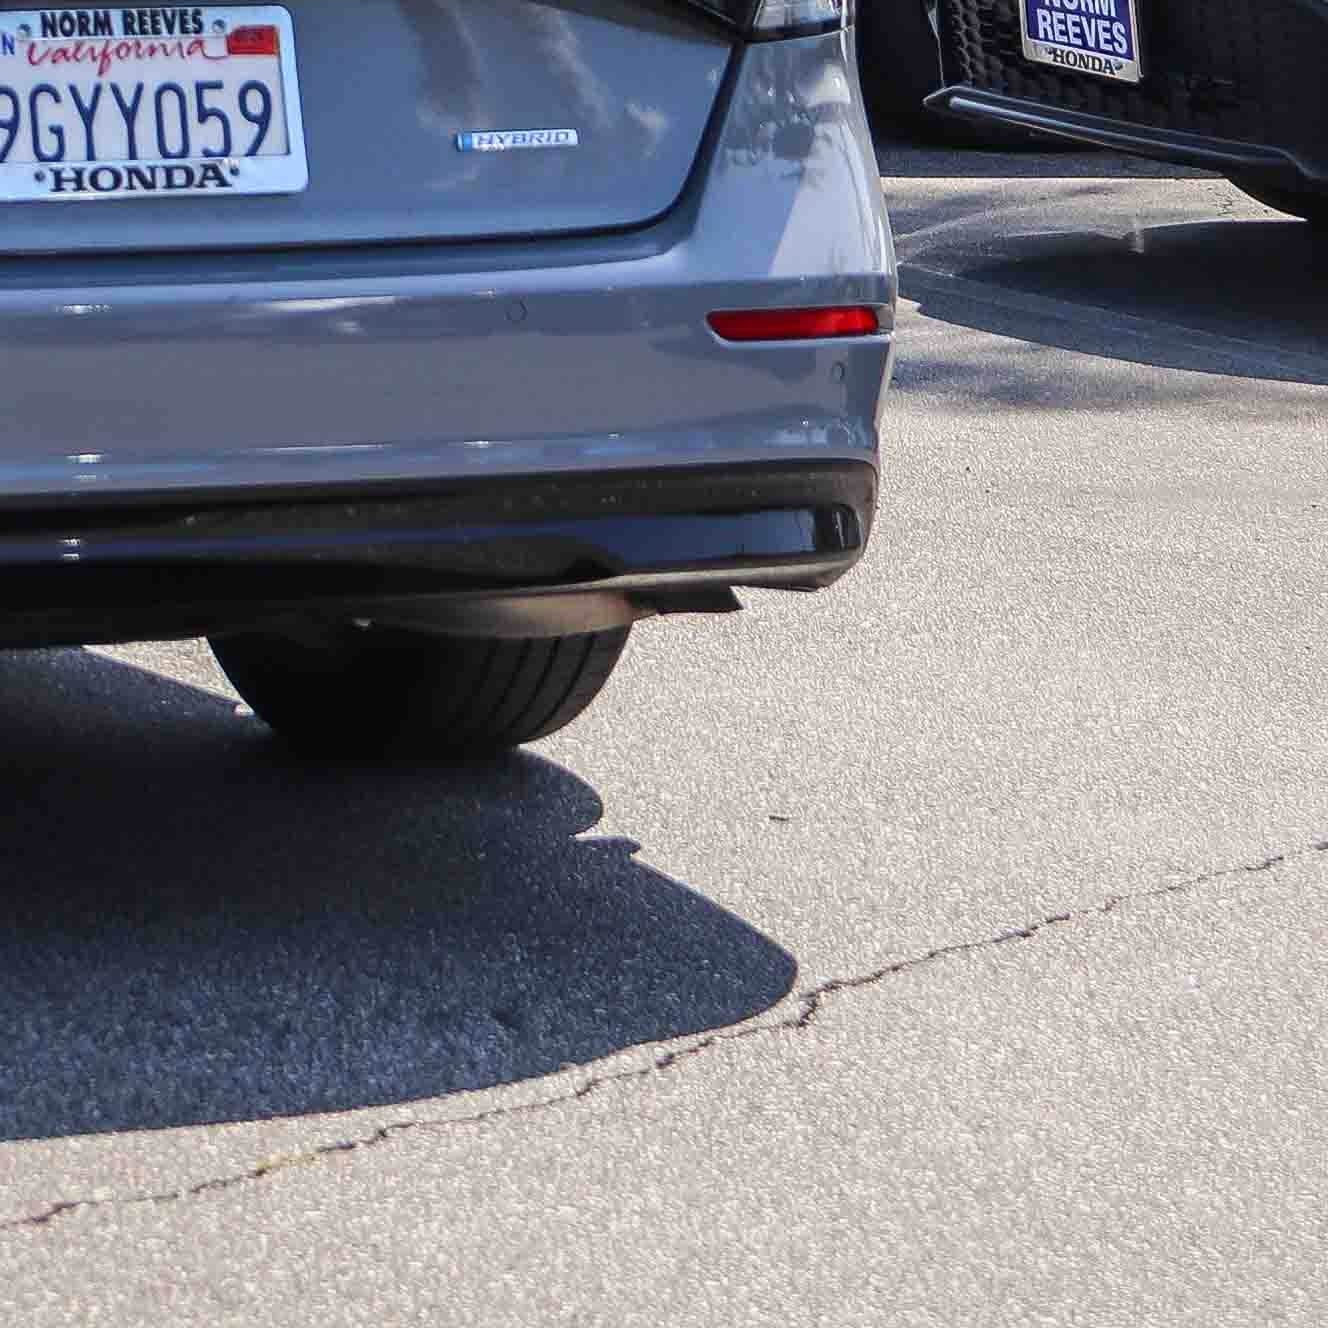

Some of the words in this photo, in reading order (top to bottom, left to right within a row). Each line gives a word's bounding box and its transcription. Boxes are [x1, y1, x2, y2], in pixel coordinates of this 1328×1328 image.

[39, 10, 114, 38] NORM
[122, 8, 204, 36] REEVES
[1036, 8, 1128, 54] REEVES
[27, 38, 229, 77] California
[1052, 49, 1116, 76] HONDA
[477, 131, 570, 145] HYBRID
[49, 162, 233, 193] HONDA
